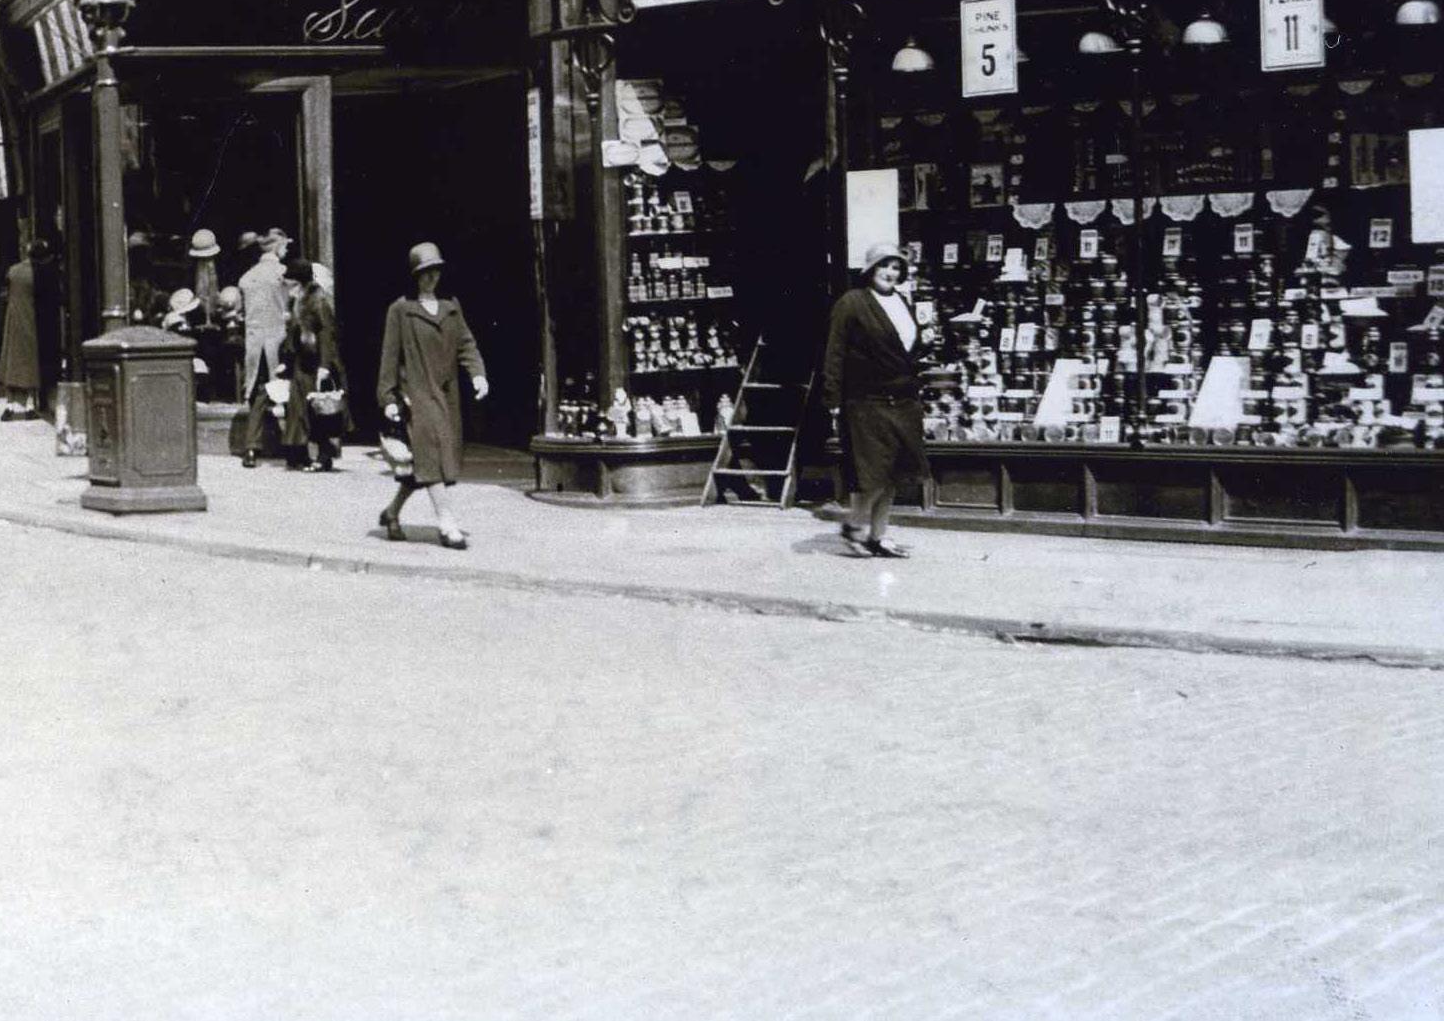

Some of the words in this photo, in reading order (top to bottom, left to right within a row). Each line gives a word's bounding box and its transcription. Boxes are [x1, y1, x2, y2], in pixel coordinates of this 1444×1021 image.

[1284, 14, 1300, 51] 11
[981, 43, 997, 77] 5
[1373, 229, 1390, 243] 12
